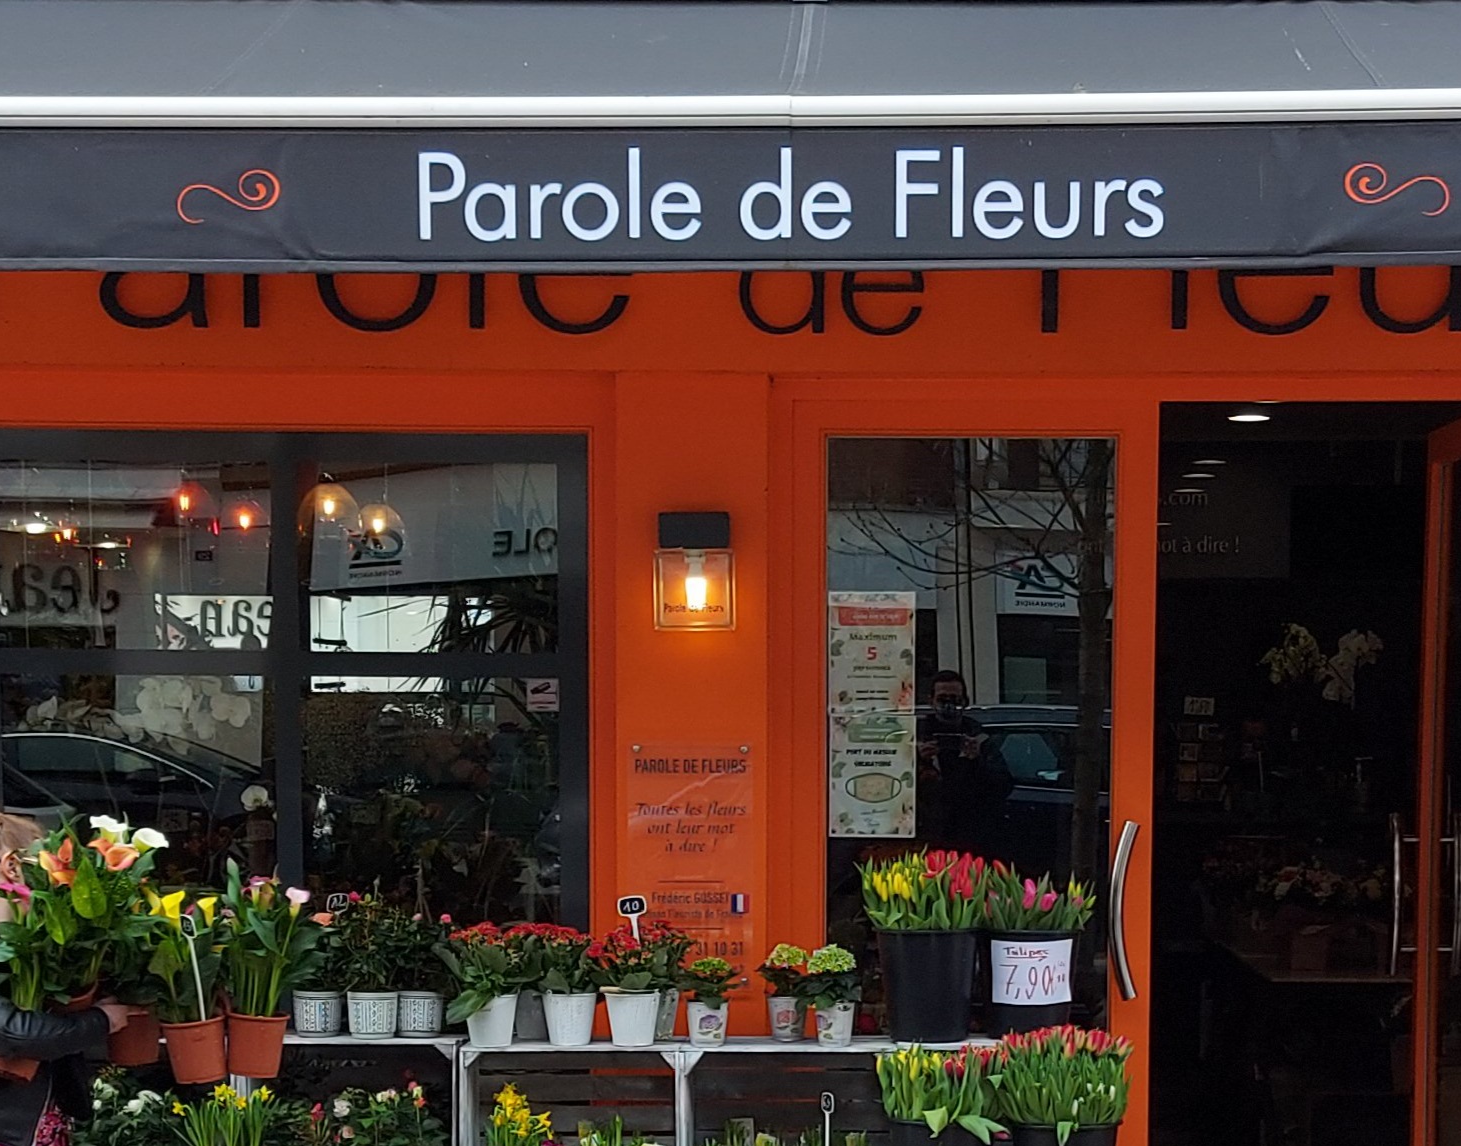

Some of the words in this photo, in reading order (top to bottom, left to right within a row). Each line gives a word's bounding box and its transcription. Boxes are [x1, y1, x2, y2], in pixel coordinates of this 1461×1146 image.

[417, 147, 701, 242] Parole
[739, 147, 852, 242] de
[895, 146, 1165, 239] Fleurs
[1196, 535, 1230, 553] dire
[866, 646, 878, 661] 5
[635, 758, 681, 775] PAROLE
[683, 758, 699, 775] DE
[701, 758, 747, 775] FLEURS
[635, 801, 681, 817] Toutes
[684, 800, 703, 816] les
[706, 801, 747, 820] fleurs
[647, 821, 671, 835] ont
[674, 821, 705, 835] leur
[707, 822, 736, 835] mot
[623, 900, 640, 913] 10
[714, 942, 727, 956] 10
[731, 942, 744, 956] 31
